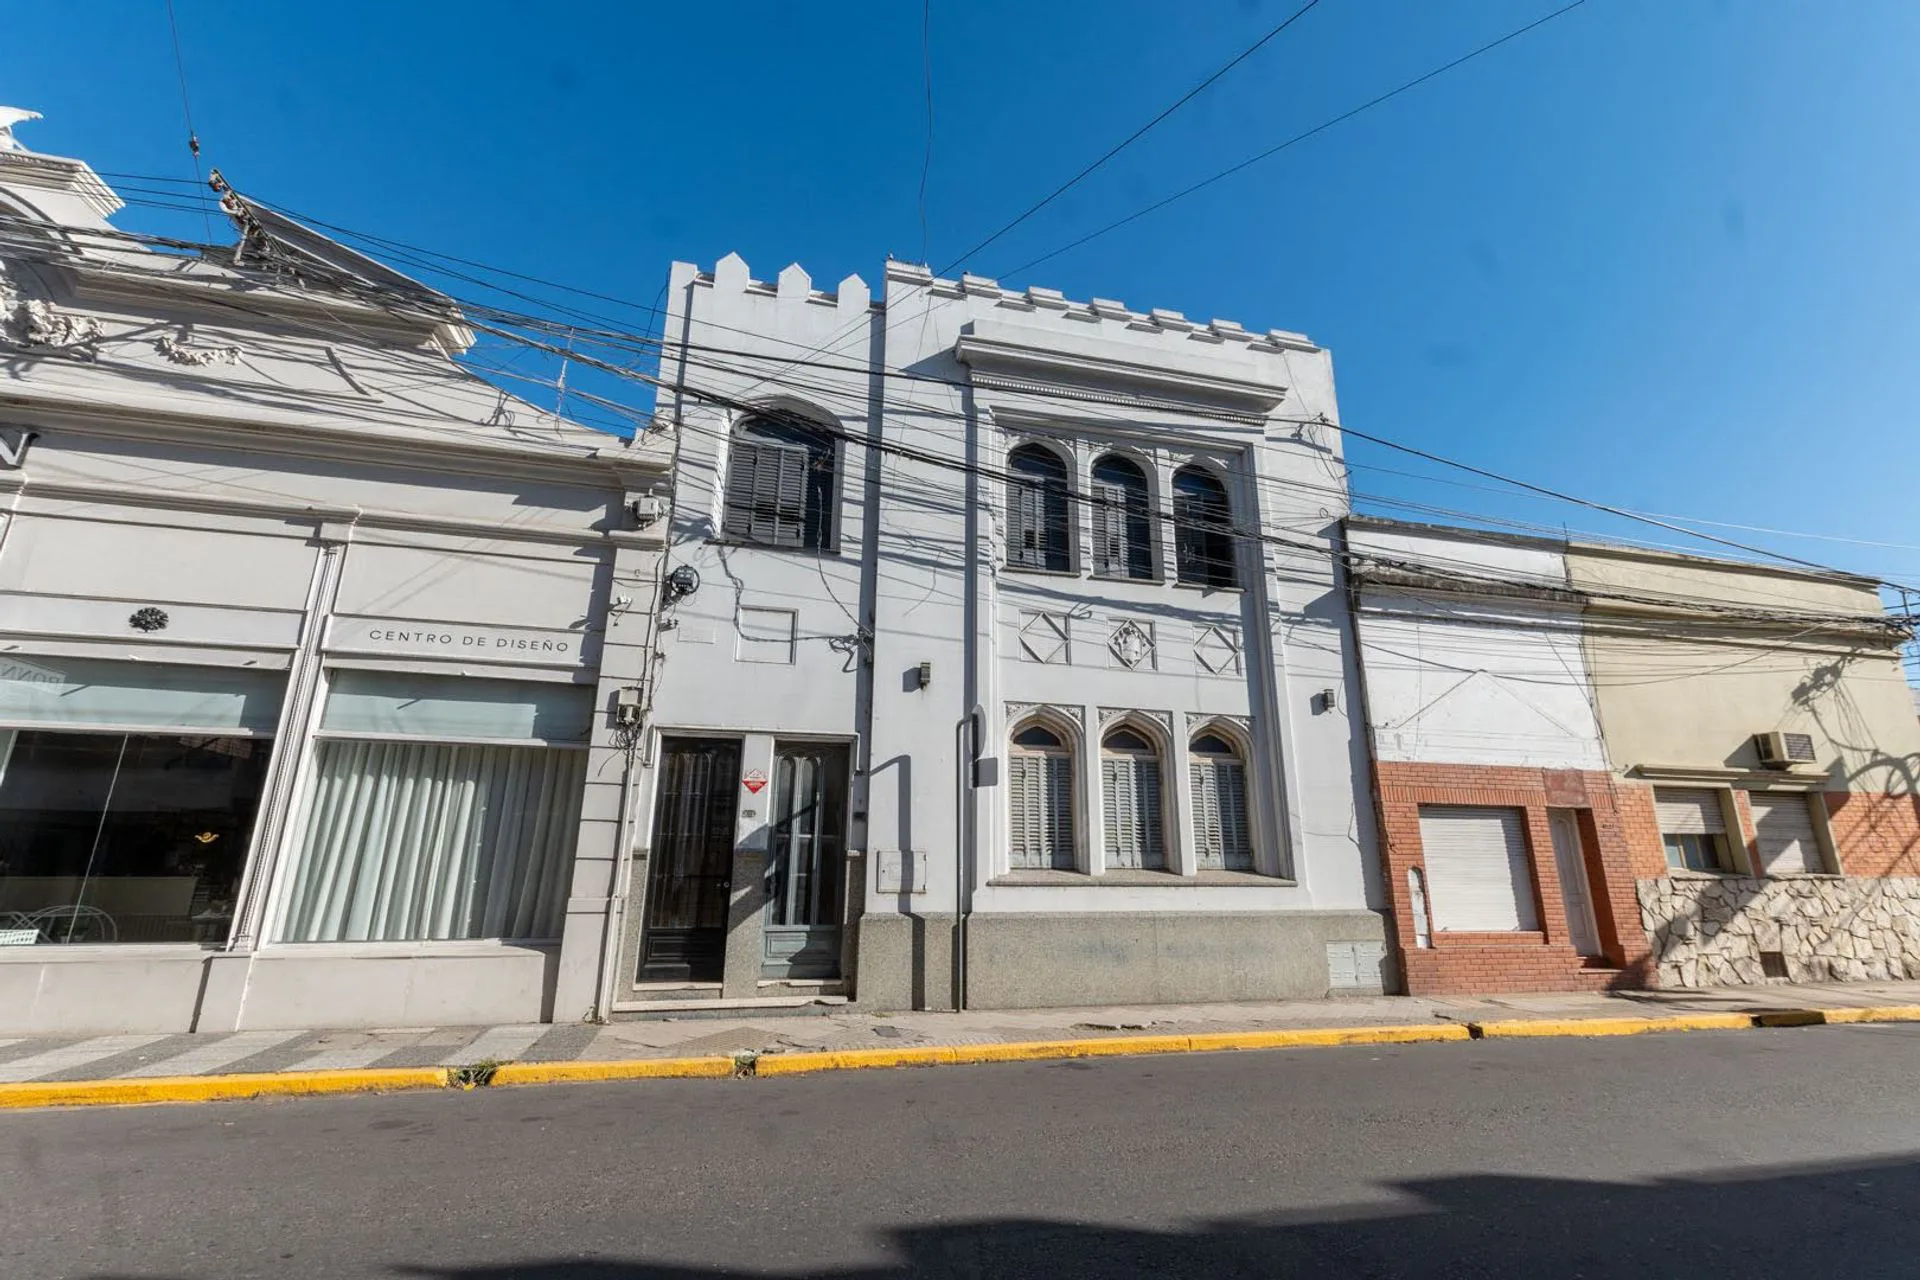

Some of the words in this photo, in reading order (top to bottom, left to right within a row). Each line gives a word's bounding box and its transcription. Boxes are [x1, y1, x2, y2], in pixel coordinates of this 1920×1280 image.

[369, 630, 452, 644] CENTRO
[462, 636, 487, 646] DE
[496, 638, 568, 652] DISEÑO
